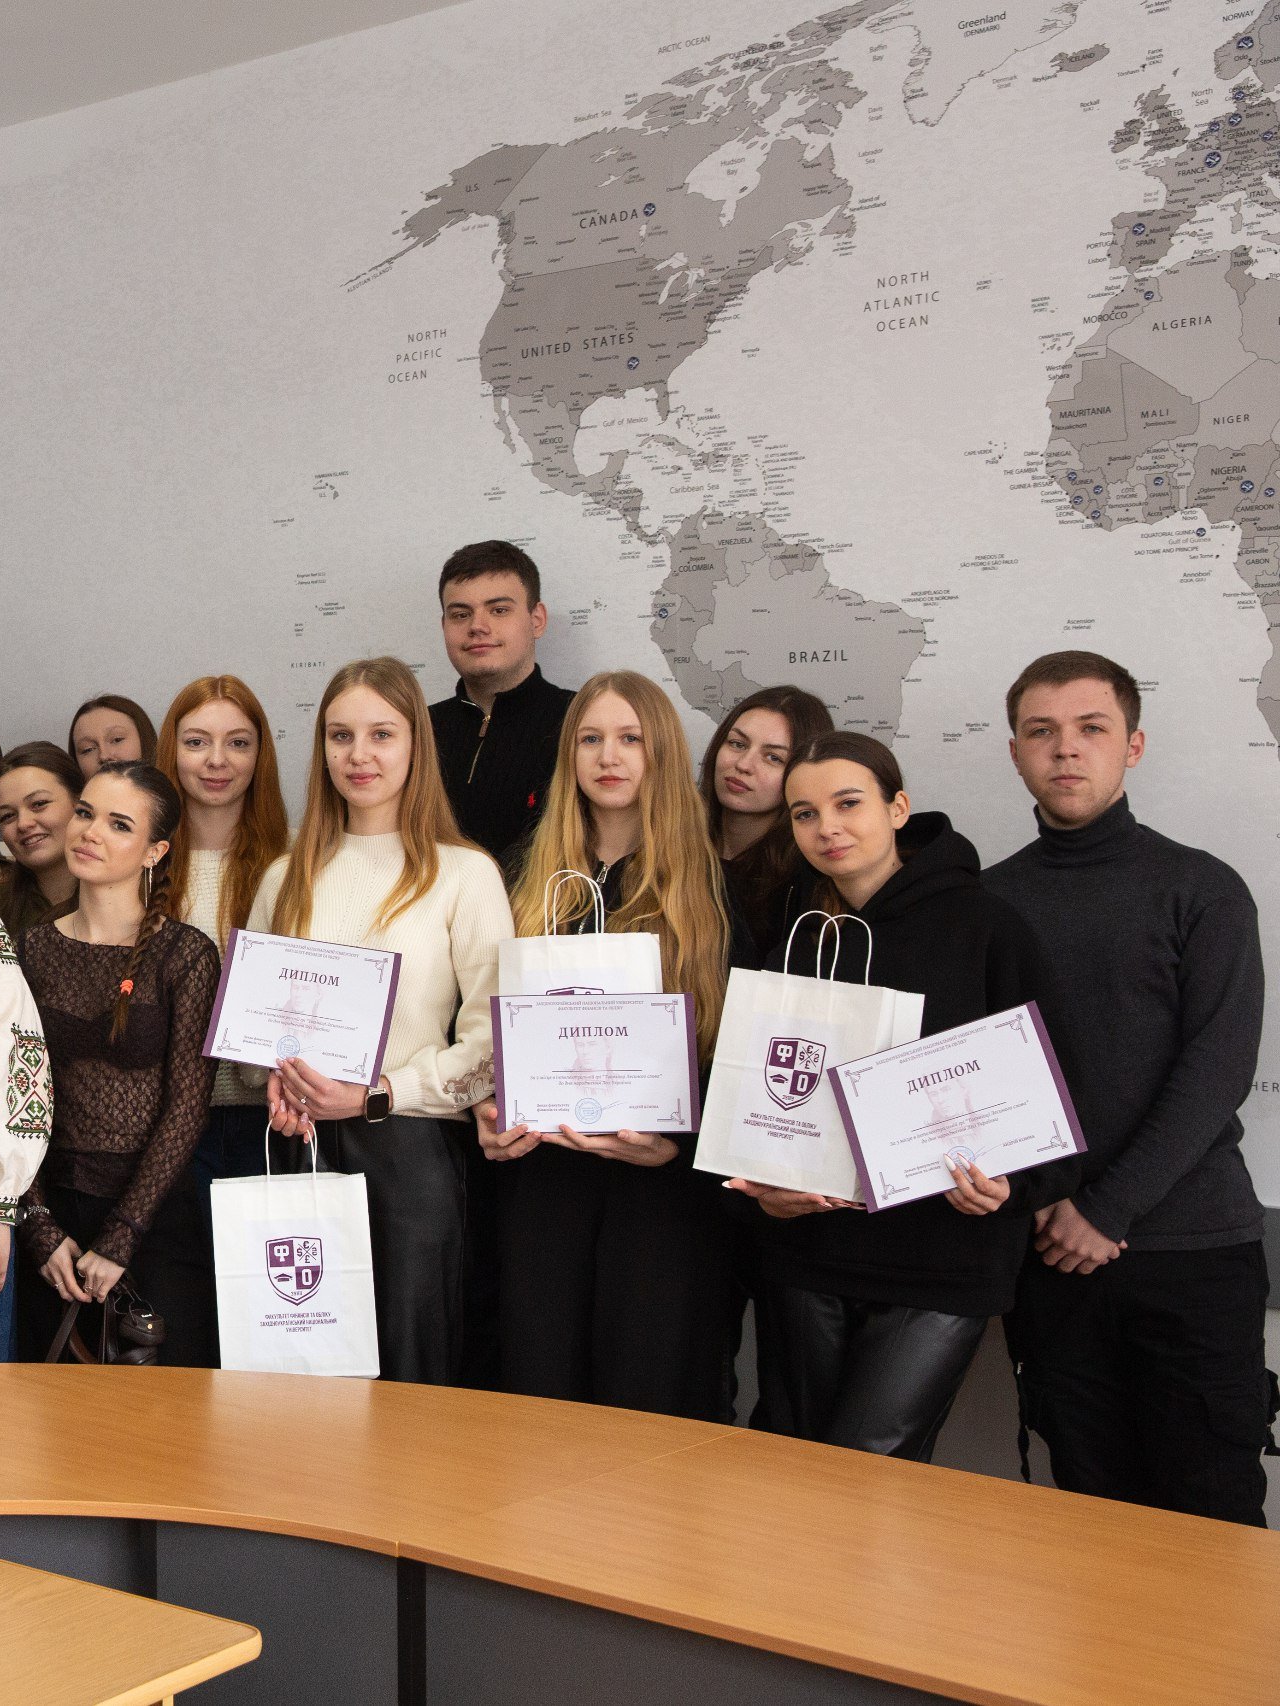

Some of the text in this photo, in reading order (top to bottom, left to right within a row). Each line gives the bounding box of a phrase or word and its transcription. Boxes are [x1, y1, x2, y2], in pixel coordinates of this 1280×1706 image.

[957, 11, 1007, 30] Greenland
[1222, 10, 1254, 23] NORWAY
[963, 24, 1000, 38] (DENMARK)
[657, 35, 711, 54] ARCTIC OCEAN
[872, 54, 883, 62] Bay
[1070, 53, 1095, 63] ICELAND
[992, 74, 1018, 84] Denmark
[1191, 87, 1213, 98] North
[1195, 98, 1209, 107] Sea
[573, 110, 612, 124] Beaufort Sea
[1156, 108, 1183, 120] UNITED
[1245, 111, 1263, 119] Berlin
[1151, 124, 1186, 136] KINGDOM
[1227, 128, 1259, 140] GERMANY
[858, 148, 883, 158] Labrador
[720, 156, 746, 167] Hudson
[1174, 160, 1189, 168] Paris
[726, 168, 738, 176] Bay
[1177, 167, 1206, 177] FRANCE
[1194, 177, 1207, 185] Lyon
[1249, 189, 1269, 198] ITALY
[579, 209, 639, 229] CANADA
[1256, 210, 1275, 219] Naples
[1189, 217, 1214, 225] Barcelona
[1149, 226, 1170, 235] Madrid
[1246, 228, 1268, 236] Palermo
[1086, 239, 1118, 250] PORTUGAL
[1135, 238, 1156, 248] SPAIN
[1193, 247, 1213, 255] Algiers
[1087, 256, 1107, 265] Lisbon
[1186, 257, 1217, 267] Constantine
[876, 270, 930, 288] NORTH
[1087, 290, 1115, 299] Casablanca
[863, 291, 940, 312] ATLANTIC
[1082, 311, 1128, 324] MOROCCO
[876, 314, 930, 332] OCEAN
[1152, 315, 1212, 332] ALGERIA
[407, 328, 447, 343] NORTH
[521, 341, 571, 359] UNITED
[583, 332, 635, 350] STATES
[396, 347, 443, 364] PACIFIC
[1045, 363, 1072, 372] Western
[388, 369, 428, 384] OCEAN
[1048, 372, 1070, 381] Sahara
[1059, 406, 1111, 419] MAURITANIA
[1140, 408, 1170, 419] MALI
[603, 416, 649, 428] Gulf of Mexico
[1212, 413, 1250, 425] NIGER
[539, 436, 564, 445] MEXICO
[1045, 450, 1071, 458] SENEGAL
[1108, 454, 1132, 462] Bamako
[1015, 467, 1039, 475] GAMBIA
[1136, 462, 1178, 471] Ouagadougou
[1210, 465, 1247, 476] NIGERIA
[1009, 480, 1052, 490] GUINEA-BISSAU
[1071, 478, 1093, 486] GUINEA
[670, 483, 720, 494] Caribbean Sea
[1040, 489, 1063, 497] Conakry
[1235, 504, 1274, 513] CAMEROON
[1058, 517, 1085, 525] Monrovia
[1140, 530, 1175, 539] EQUATORIAL
[718, 537, 753, 546] VENEZUELA
[1189, 536, 1211, 544] Guinea
[773, 552, 799, 560] SURINAME
[1240, 547, 1269, 555] Libreville
[678, 563, 714, 573] COLOMBIA
[673, 656, 690, 664] PERU
[788, 649, 848, 664] BRAZIL
[290, 661, 326, 669] KIRIBATI
[278, 967, 340, 987] ДИПЛОМ
[558, 1026, 629, 1040] ДИПЛОМ
[906, 1059, 981, 1095] ДИПЛОМ
